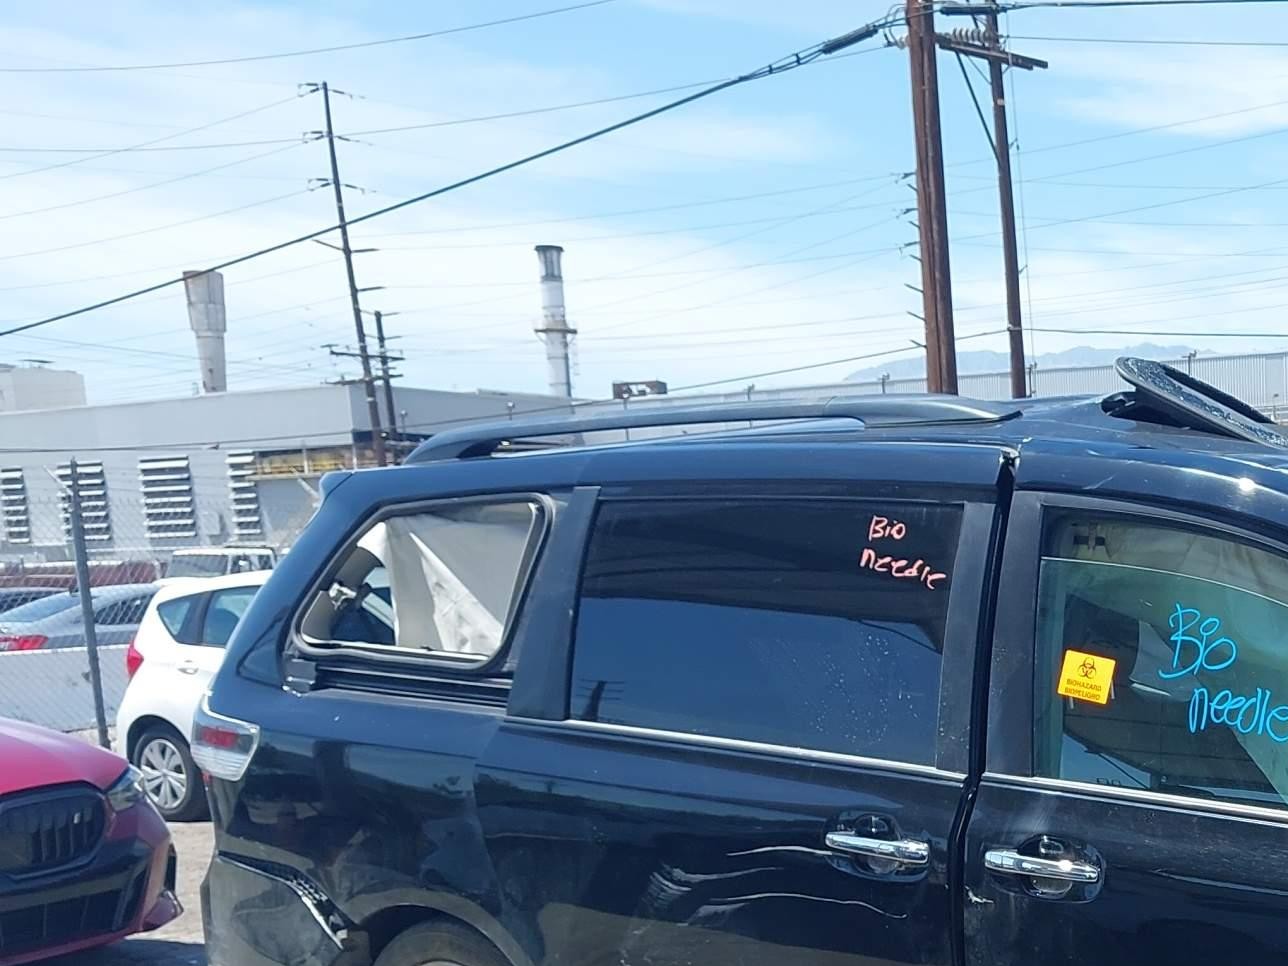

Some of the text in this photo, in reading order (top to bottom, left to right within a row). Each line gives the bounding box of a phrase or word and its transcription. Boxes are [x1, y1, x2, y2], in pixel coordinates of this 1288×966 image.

[860, 548, 947, 590] needle
[1158, 602, 1237, 679] Bio
[1066, 678, 1102, 692] BIOHAZARD
